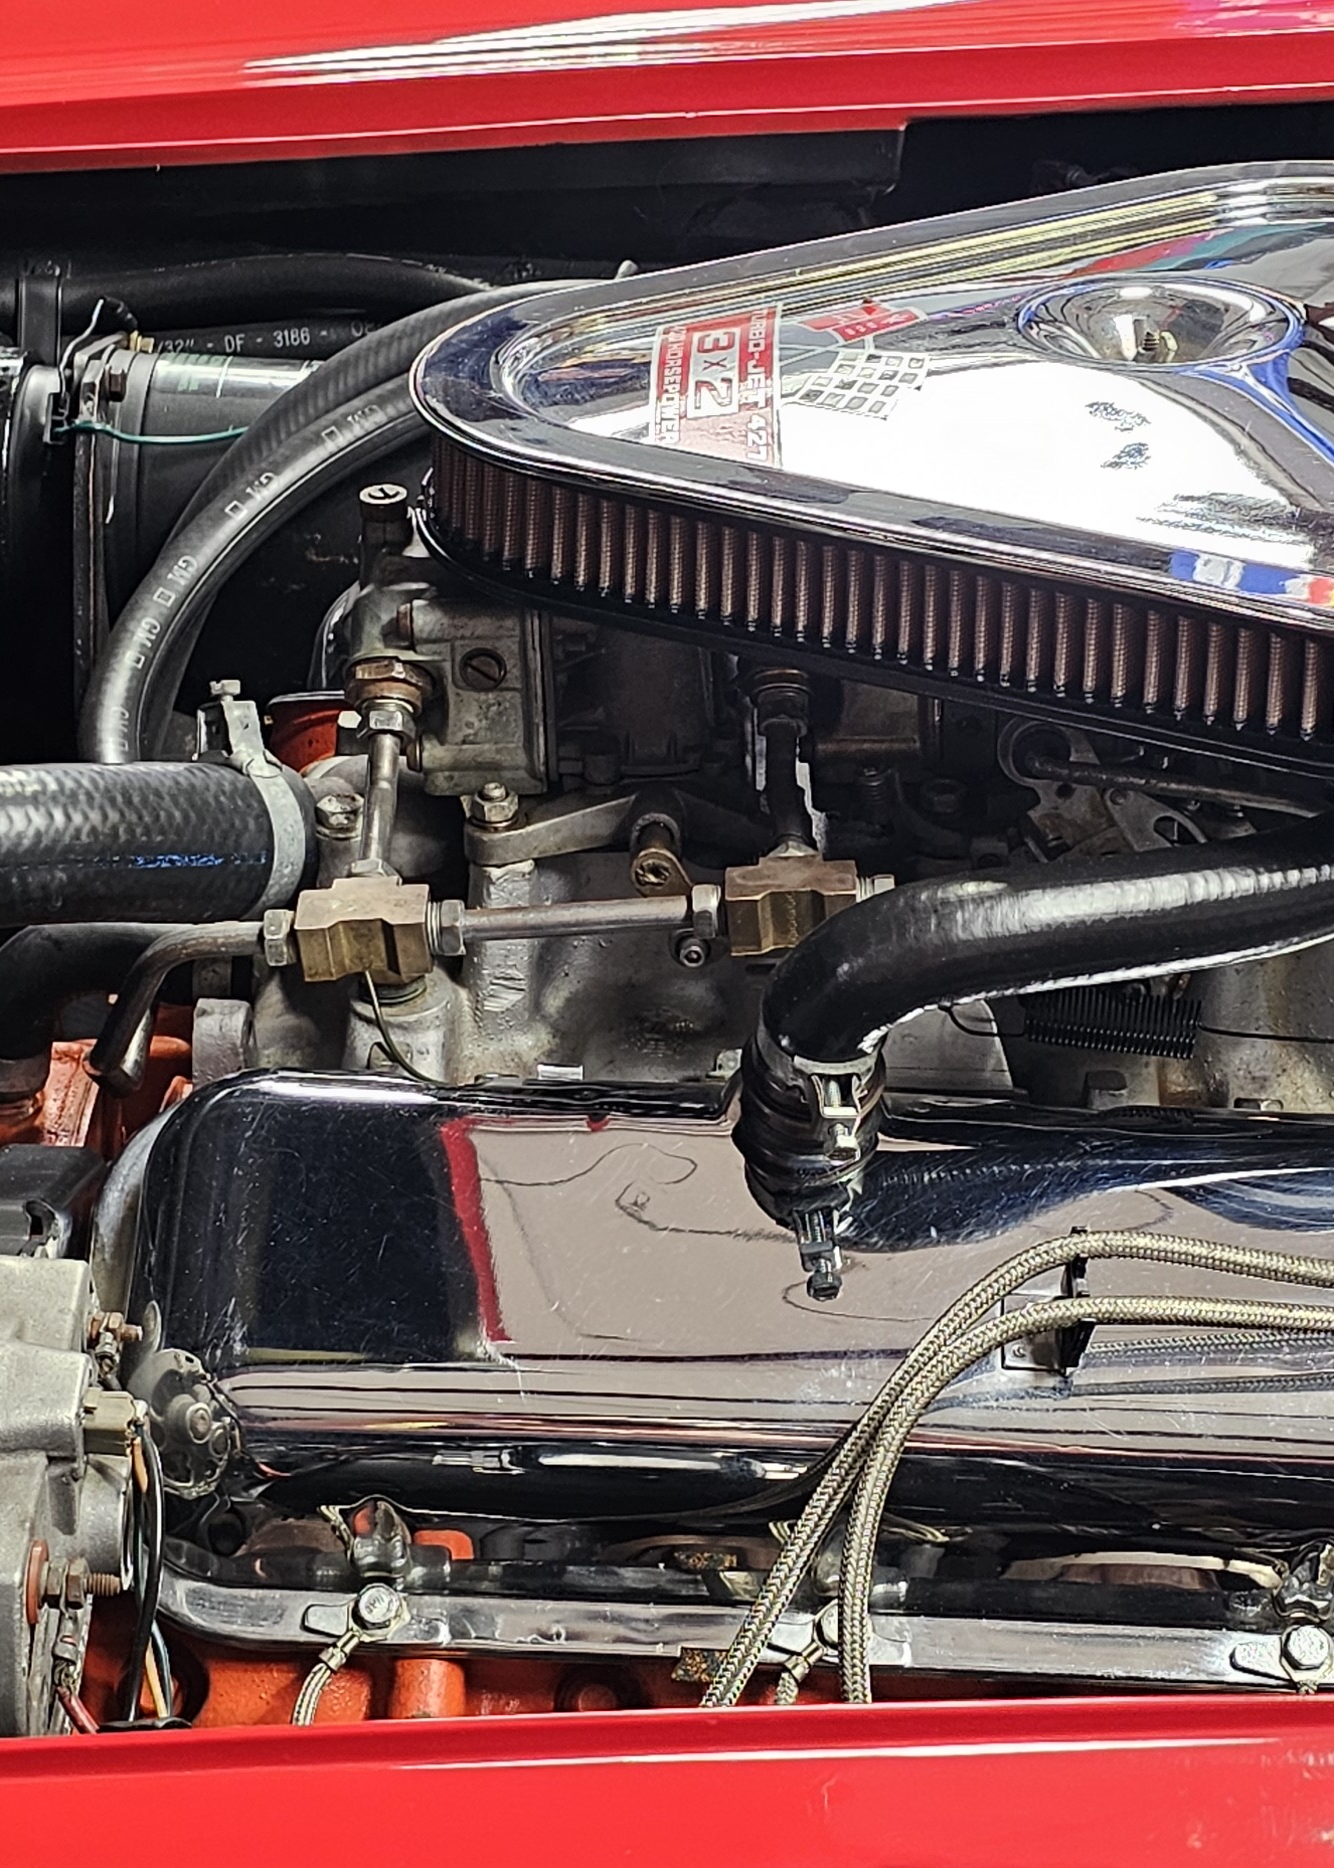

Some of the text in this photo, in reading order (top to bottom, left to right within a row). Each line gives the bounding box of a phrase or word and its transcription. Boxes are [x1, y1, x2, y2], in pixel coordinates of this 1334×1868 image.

[224, 334, 245, 353] DF
[273, 327, 311, 348] 3186
[661, 341, 684, 444] HORSEPOWER
[746, 414, 767, 461] 427
[168, 555, 198, 586] GM
[133, 616, 161, 648] GM
